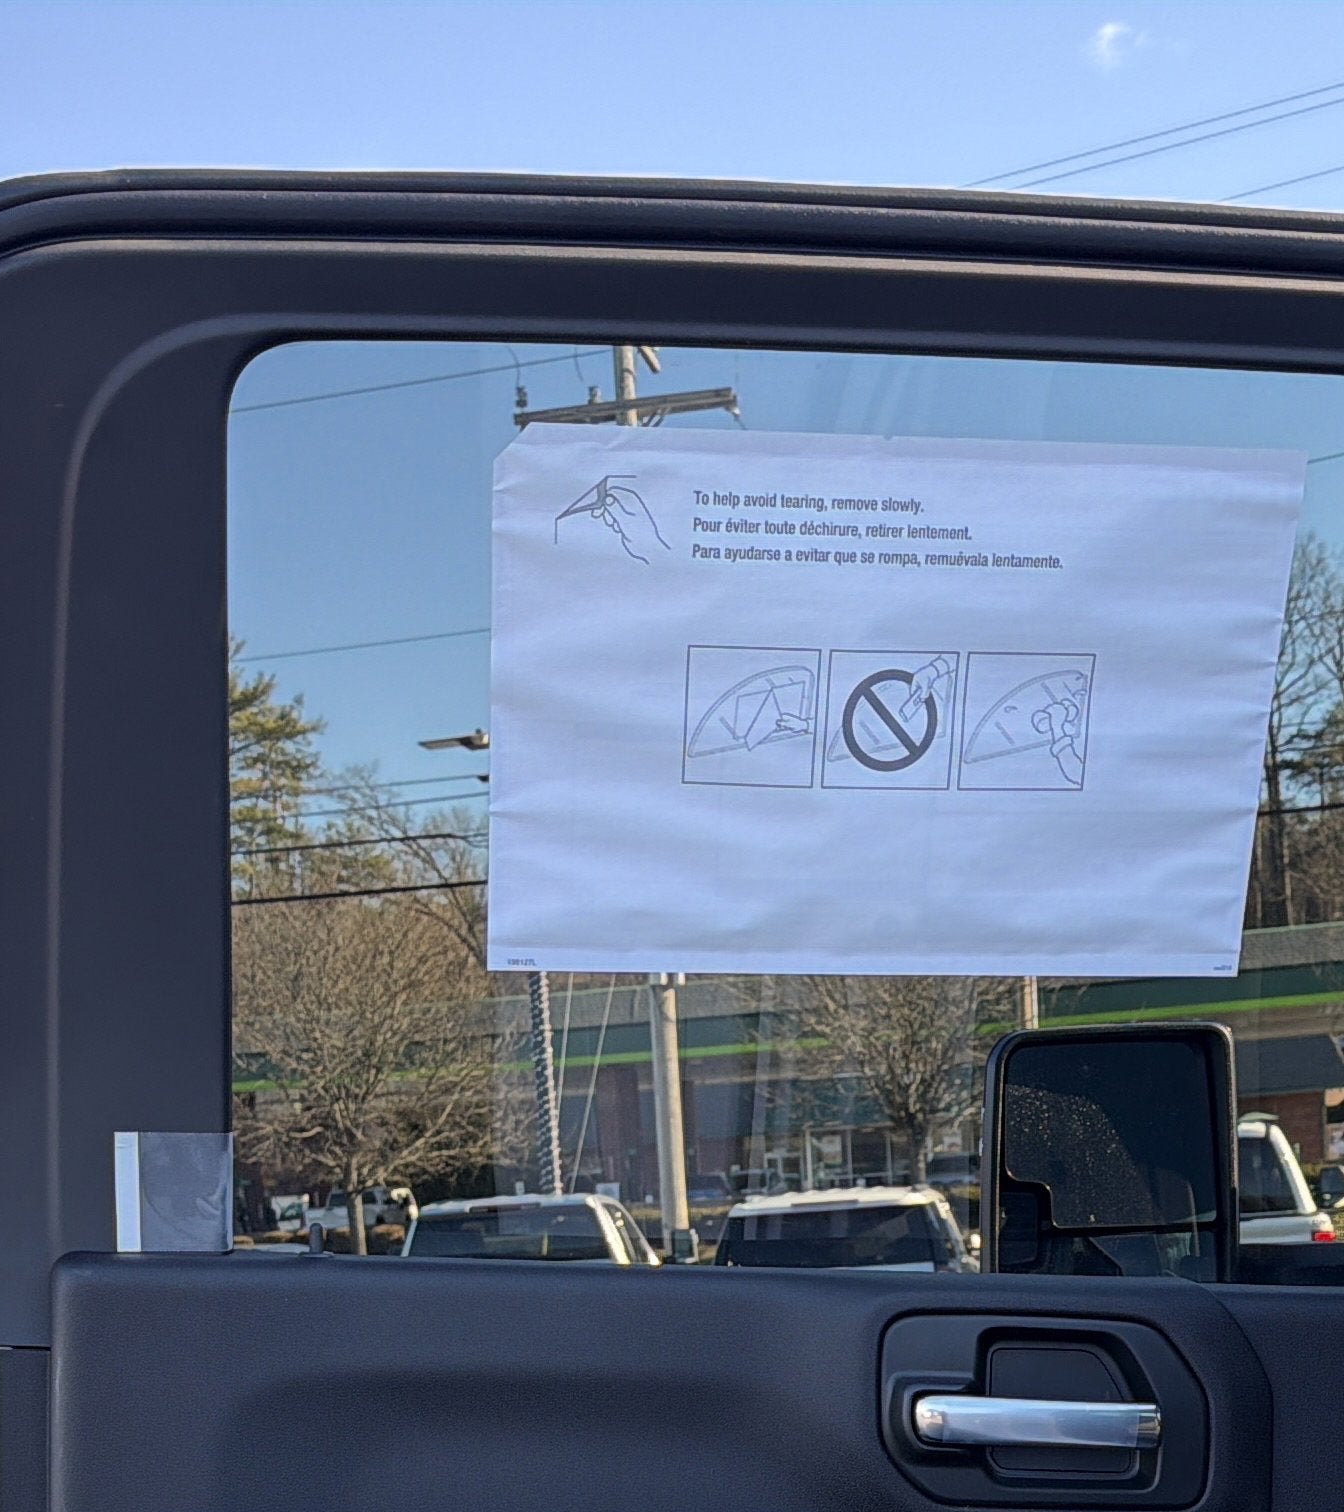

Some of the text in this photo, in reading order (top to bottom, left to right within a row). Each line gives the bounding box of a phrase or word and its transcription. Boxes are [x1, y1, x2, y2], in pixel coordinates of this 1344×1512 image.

[693, 490, 924, 515] To help avoid tearing, remove slowly.
[693, 517, 972, 540] Pour éviter toute déchirure, retirer lentement.
[692, 544, 1063, 569] Para ayudarse a evitar que se rompa, remuévala lentamente.
